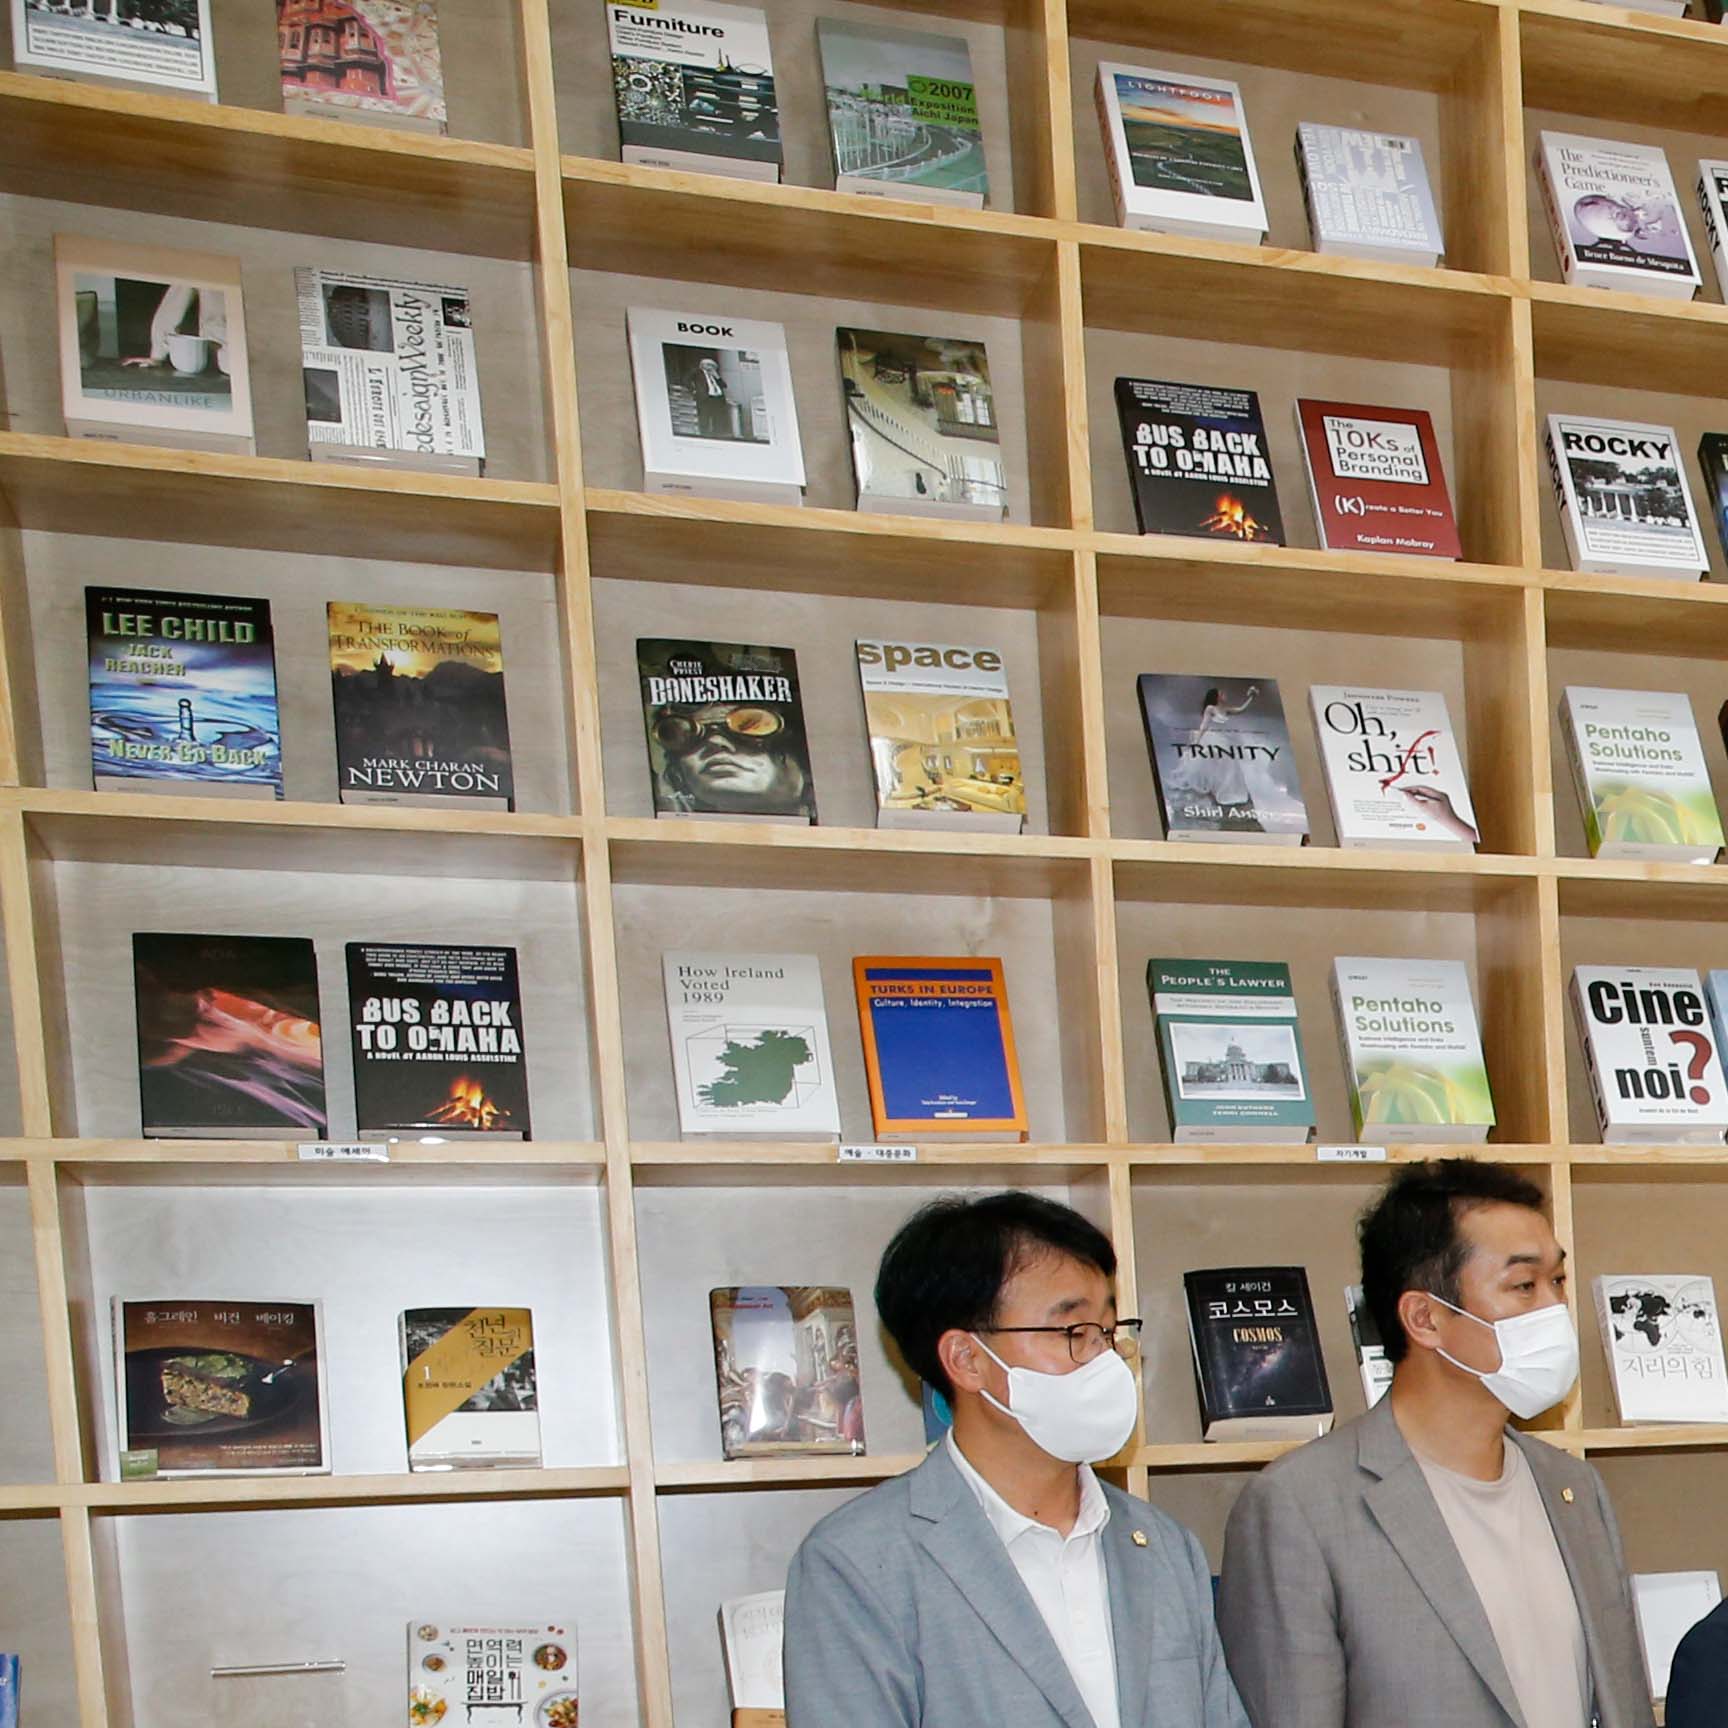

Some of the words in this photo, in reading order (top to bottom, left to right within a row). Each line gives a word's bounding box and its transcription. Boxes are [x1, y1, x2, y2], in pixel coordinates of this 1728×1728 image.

[613, 8, 725, 39] Furniture
[928, 81, 973, 101] 2007
[1128, 79, 1223, 102] LIGHTFOOT
[910, 97, 976, 114] Exposition
[912, 107, 942, 121] Aichi
[944, 112, 979, 126] Japan
[1560, 148, 1584, 163] The
[1559, 161, 1661, 189] Predictioneer's
[1564, 177, 1607, 193] Game
[676, 321, 734, 338] BOOK
[104, 388, 214, 409] URBANLIKE
[1328, 418, 1354, 431] The
[1136, 422, 1186, 449] BUS
[1192, 428, 1259, 456] BACK
[1331, 428, 1399, 453] 10Ks
[1403, 443, 1417, 454] of
[1563, 430, 1672, 461] ROCKY
[1132, 443, 1166, 470] TO
[1175, 449, 1272, 481] OMAHA
[1336, 446, 1420, 467] Personal
[1338, 459, 1424, 482] Branding
[1427, 508, 1444, 518] You
[1356, 532, 1394, 547] Kaplan
[102, 612, 153, 638] LEE
[161, 615, 257, 644] CHILD
[357, 620, 392, 638] THE
[396, 623, 448, 641] BOOK
[455, 627, 472, 642] of
[127, 643, 174, 660] JACK
[334, 633, 496, 659] TRANSFORMATIONS
[858, 642, 1002, 673] space
[104, 657, 187, 678] REACHER
[649, 675, 793, 705] BONESHAKER
[1324, 701, 1398, 740] Oh,
[1584, 722, 1672, 744] Pentaho
[1171, 742, 1281, 763] TRINITY
[1589, 740, 1684, 763] Solutions
[362, 757, 412, 771] MARK
[414, 759, 485, 774] CHARAN
[348, 765, 500, 793] NEWTON
[1183, 804, 1223, 820] Shirl
[677, 964, 721, 979] How
[724, 966, 785, 981] Ireland
[1160, 973, 1226, 989] PEOPLE'S
[1229, 977, 1286, 990] LAWYER
[1209, 967, 1231, 977] THE
[679, 979, 730, 992] Voted
[870, 984, 915, 995] TURKS
[918, 984, 935, 995] IN
[939, 984, 994, 995] EUROPE
[682, 991, 725, 1004] 1989
[873, 999, 908, 1009] Culture,
[910, 999, 947, 1010] Identity,
[948, 999, 993, 1010] Integration
[1352, 995, 1443, 1014] Pentaho
[1586, 979, 1706, 1027] Cine
[361, 996, 421, 1025] BUS
[430, 998, 513, 1028] BACK
[1356, 1015, 1455, 1034] Solutions
[355, 1024, 395, 1052] TO
[411, 1024, 522, 1054] OMAHA
[1640, 1026, 1657, 1067] suntem
[375, 1050, 402, 1060] NOVEL
[416, 1051, 444, 1061] AARON
[445, 1052, 469, 1062] LOUIS
[844, 1148, 862, 1158] 예술
[875, 1148, 912, 1158] 대중문화
[1239, 1281, 1272, 1293] 세이건
[143, 1309, 199, 1325] 홀그레인
[213, 1311, 241, 1326] 비건
[255, 1311, 295, 1326] 베이킹
[1208, 1299, 1299, 1320] 코스모스
[1232, 1326, 1283, 1344] COSMOS
[470, 1336, 521, 1358] 질문
[422, 1365, 432, 1381] 1
[1623, 1355, 1689, 1380] 지리의
[1692, 1356, 1713, 1380] 힘
[465, 1638, 523, 1654] 면역력
[465, 1654, 523, 1669] 높이는
[466, 1670, 504, 1685] 매일
[466, 1685, 505, 1701] 집밥
